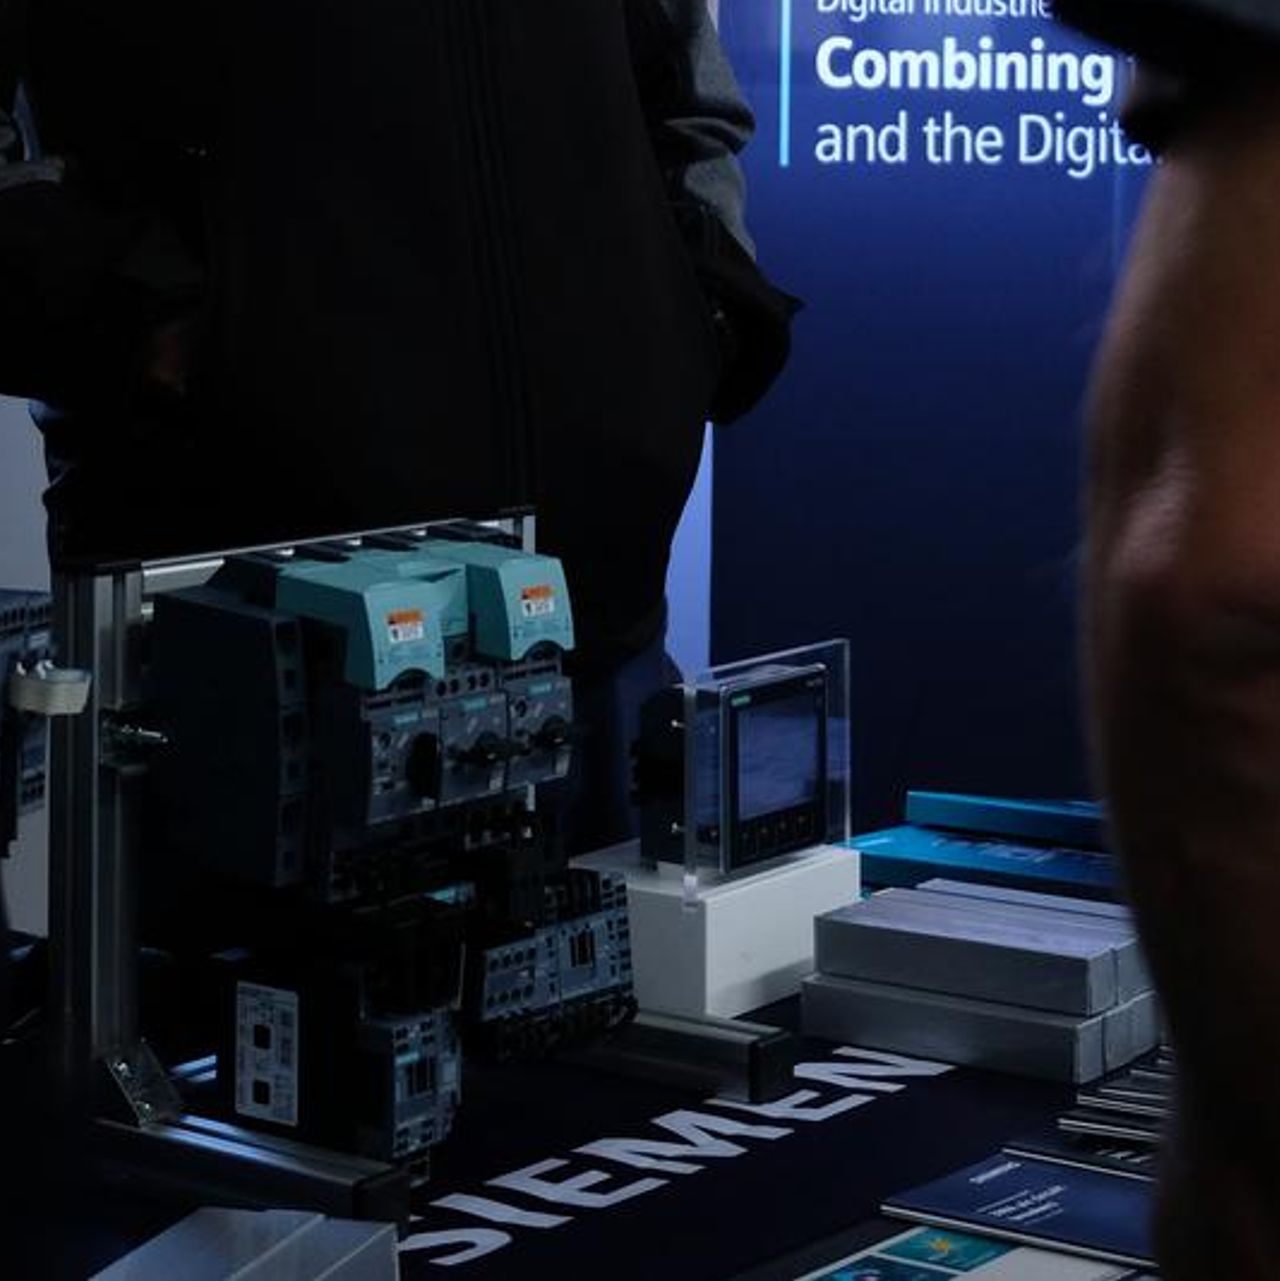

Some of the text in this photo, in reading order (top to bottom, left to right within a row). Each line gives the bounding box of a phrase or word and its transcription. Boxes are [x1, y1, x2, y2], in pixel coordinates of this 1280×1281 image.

[815, 35, 1116, 106] Combining
[814, 109, 1165, 180] and the Digita
[399, 1045, 959, 1267] SIEMEN
